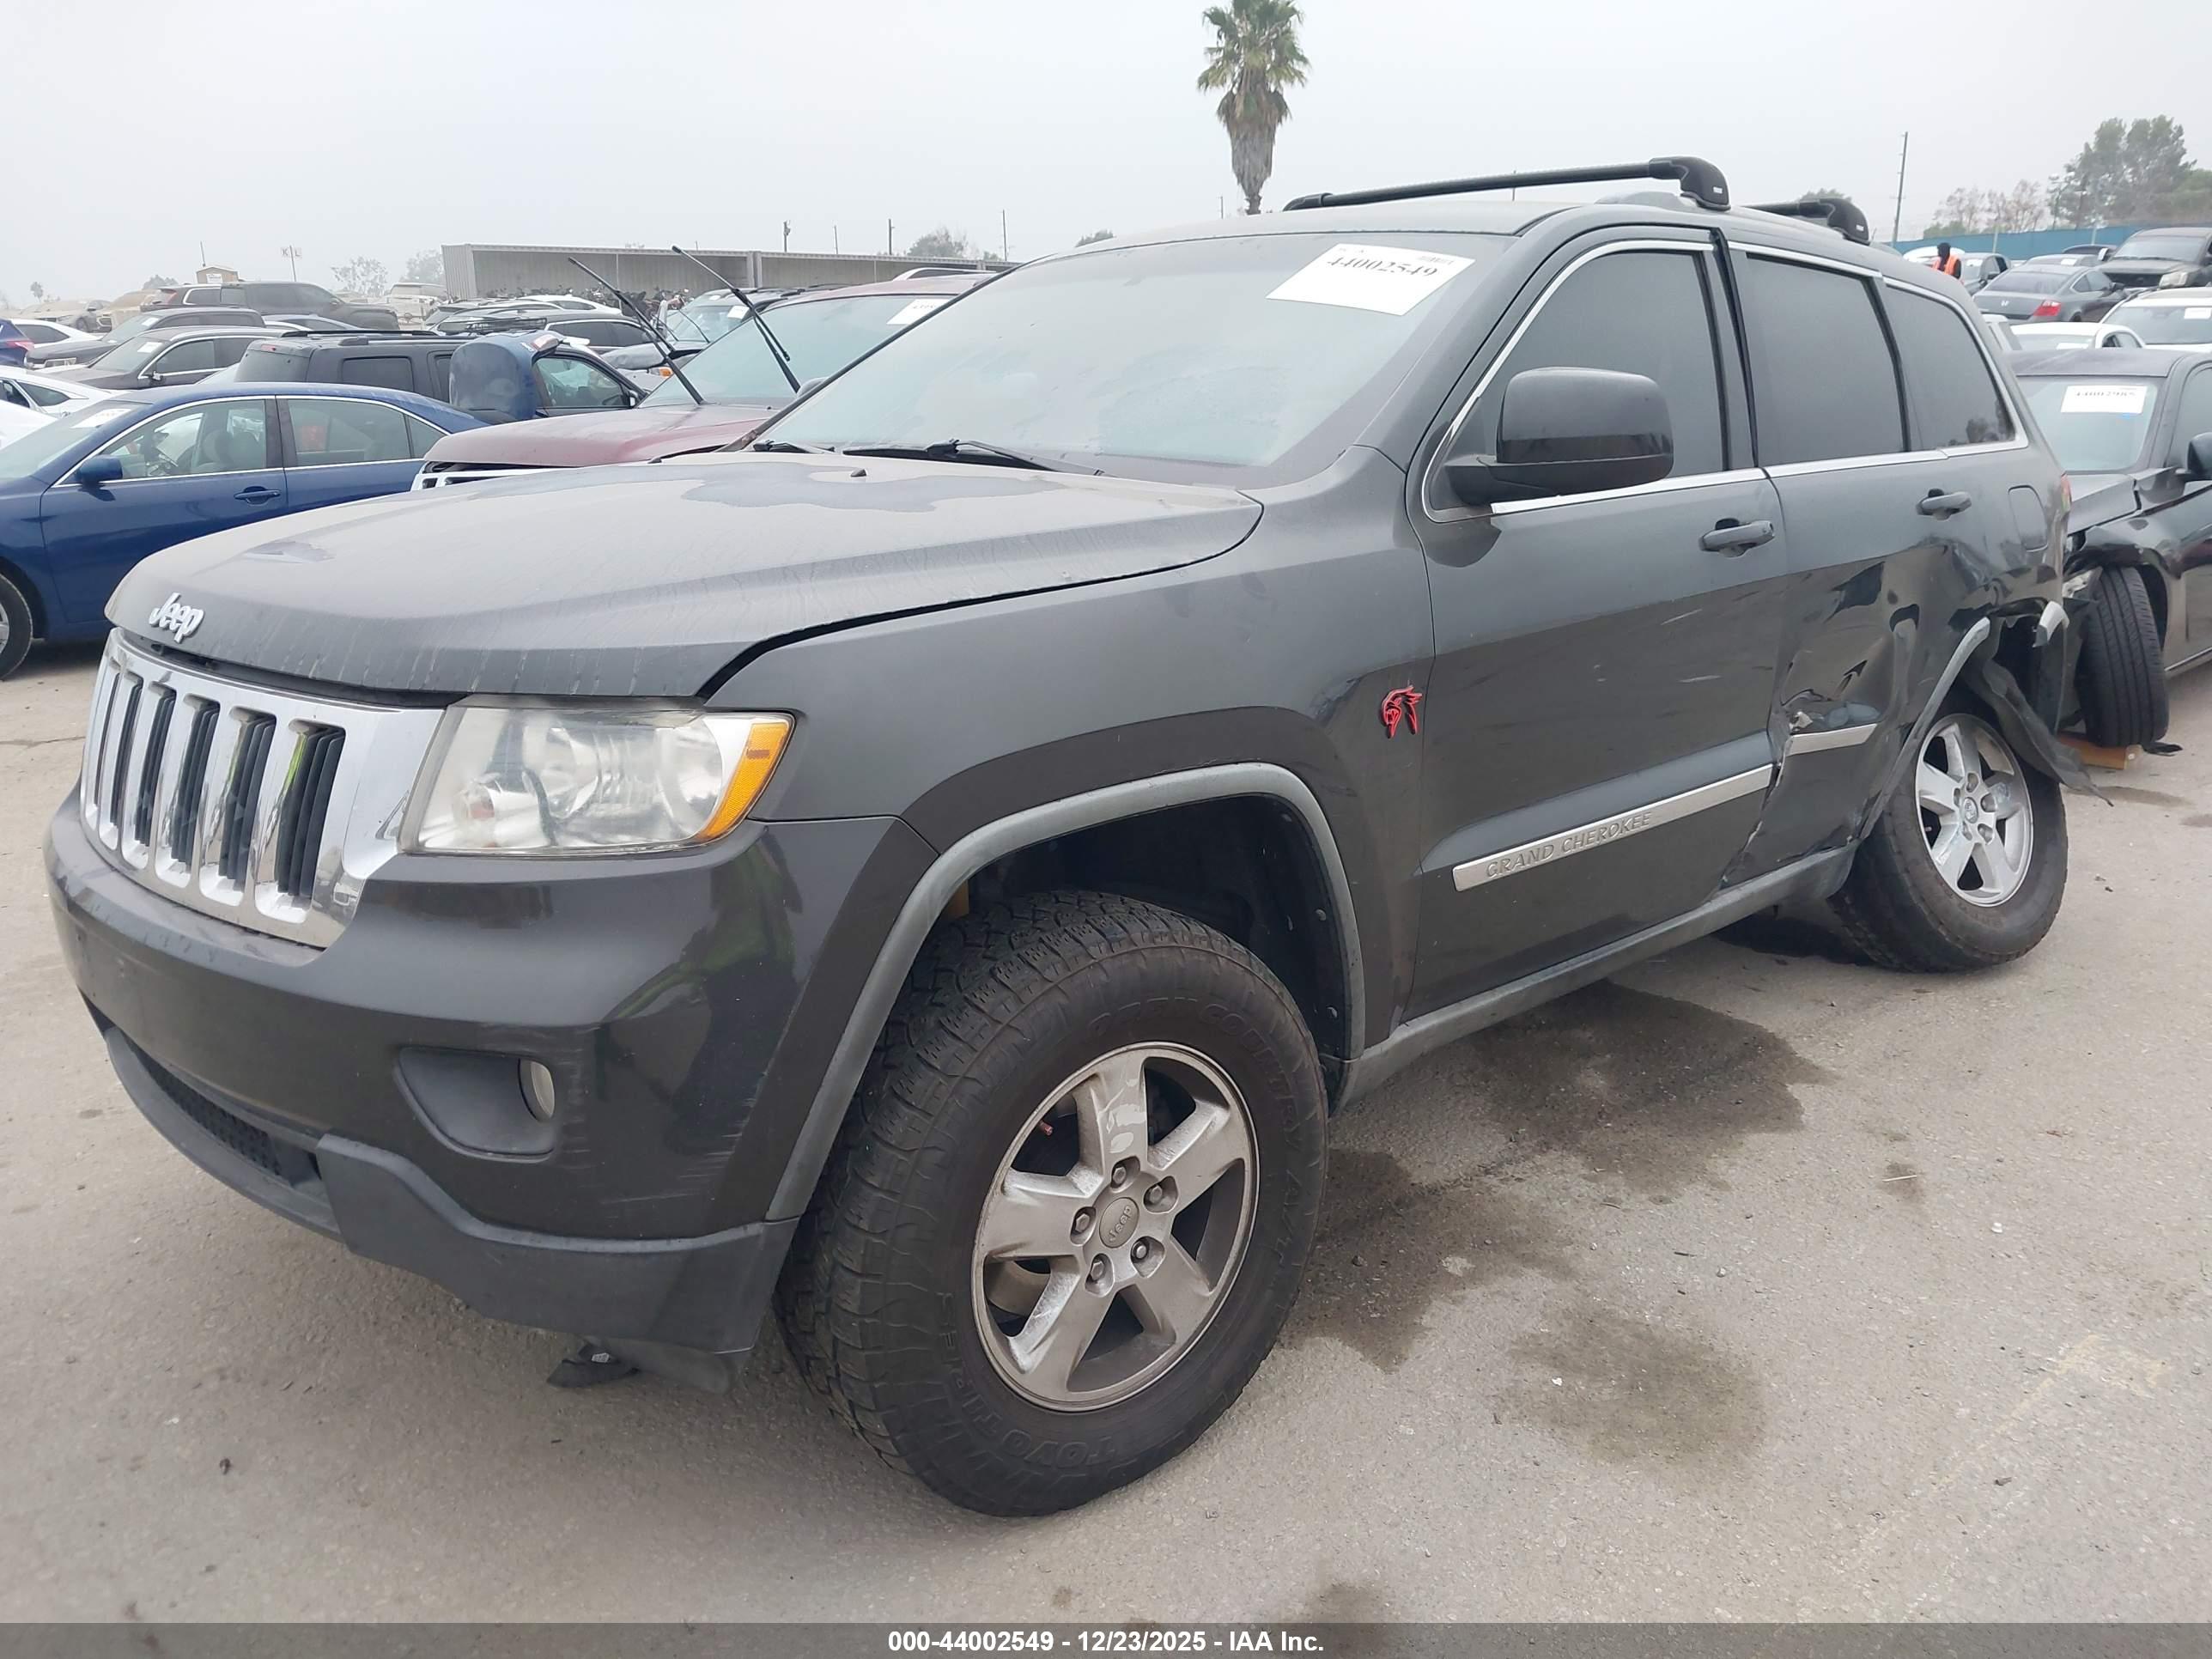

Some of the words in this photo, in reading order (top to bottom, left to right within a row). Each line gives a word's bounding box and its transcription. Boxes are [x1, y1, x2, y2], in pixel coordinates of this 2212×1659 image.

[1327, 257, 1438, 276] 44002549
[149, 592, 204, 644] Jeep
[1486, 845, 1553, 879] GRAND
[1561, 812, 1652, 854] CHEROKEE
[1108, 1204, 1132, 1243] Jeep
[999, 1424, 1114, 1468] TOYO
